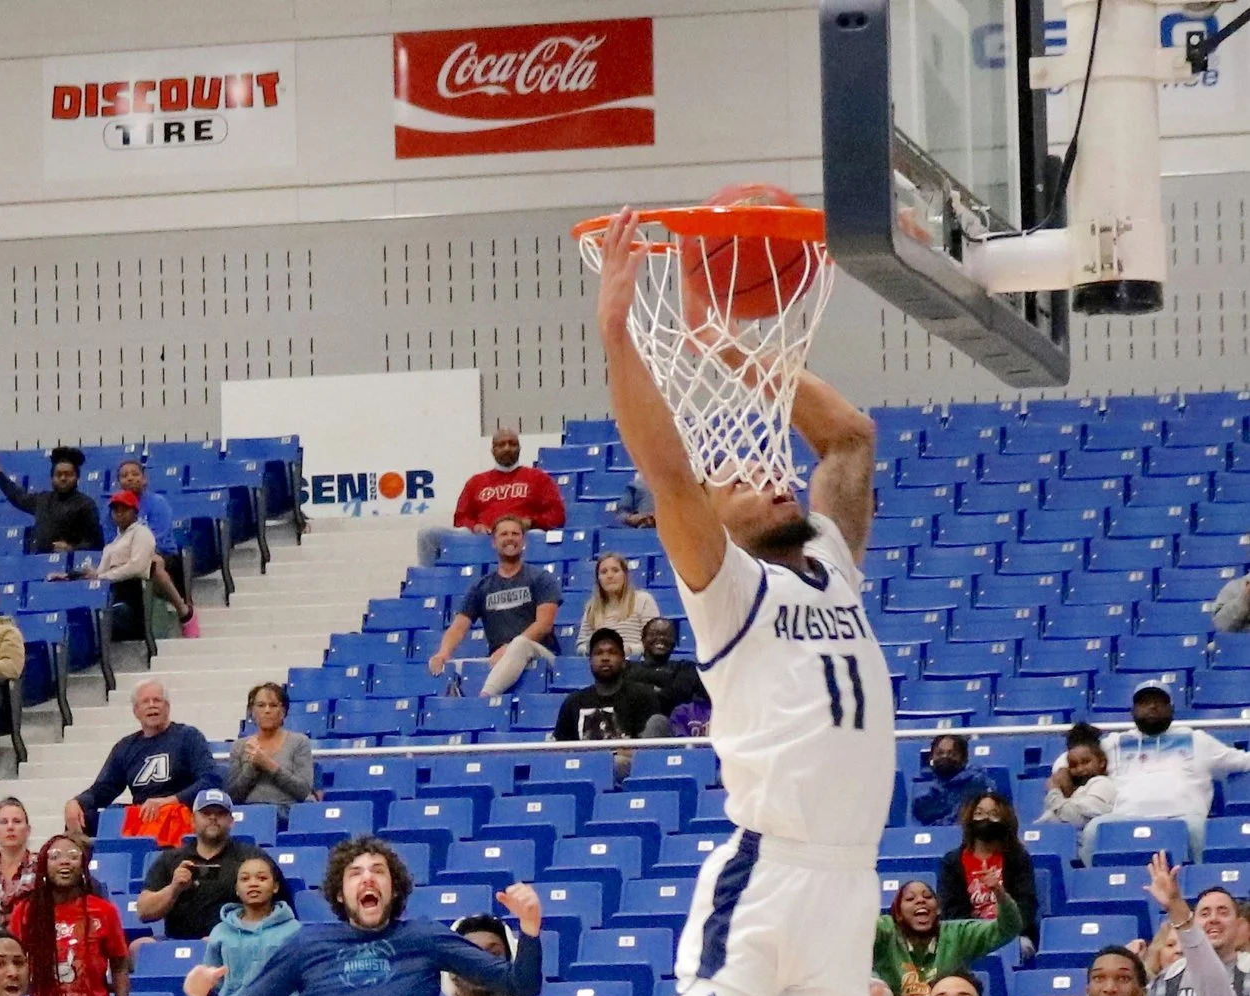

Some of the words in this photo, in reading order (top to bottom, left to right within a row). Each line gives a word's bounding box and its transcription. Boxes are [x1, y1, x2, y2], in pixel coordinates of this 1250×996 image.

[437, 34, 608, 99] Coca-Cola
[52, 71, 280, 120] DISCOUNT
[115, 119, 214, 146] TIRE
[820, 654, 865, 729] 11
[344, 958, 391, 973] AUGUSTA
